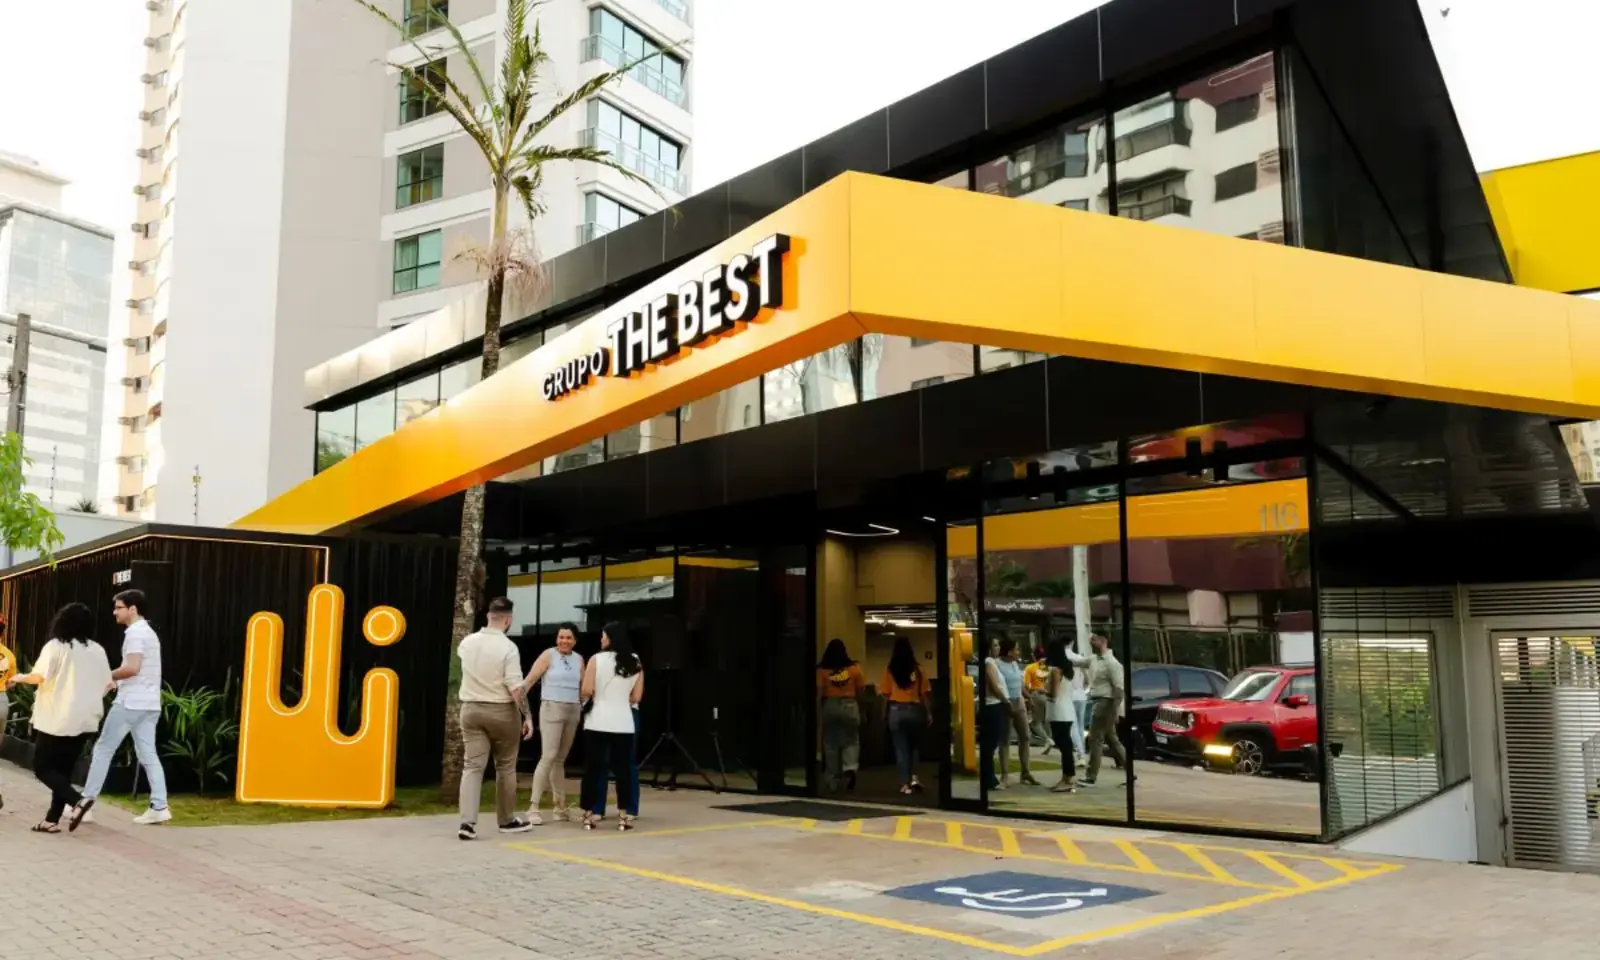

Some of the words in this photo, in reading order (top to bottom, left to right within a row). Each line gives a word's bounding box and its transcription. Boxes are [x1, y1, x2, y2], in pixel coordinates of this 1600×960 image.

[543, 347, 607, 400] GRUPO
[607, 293, 672, 376] THE
[678, 233, 785, 346] BEST
